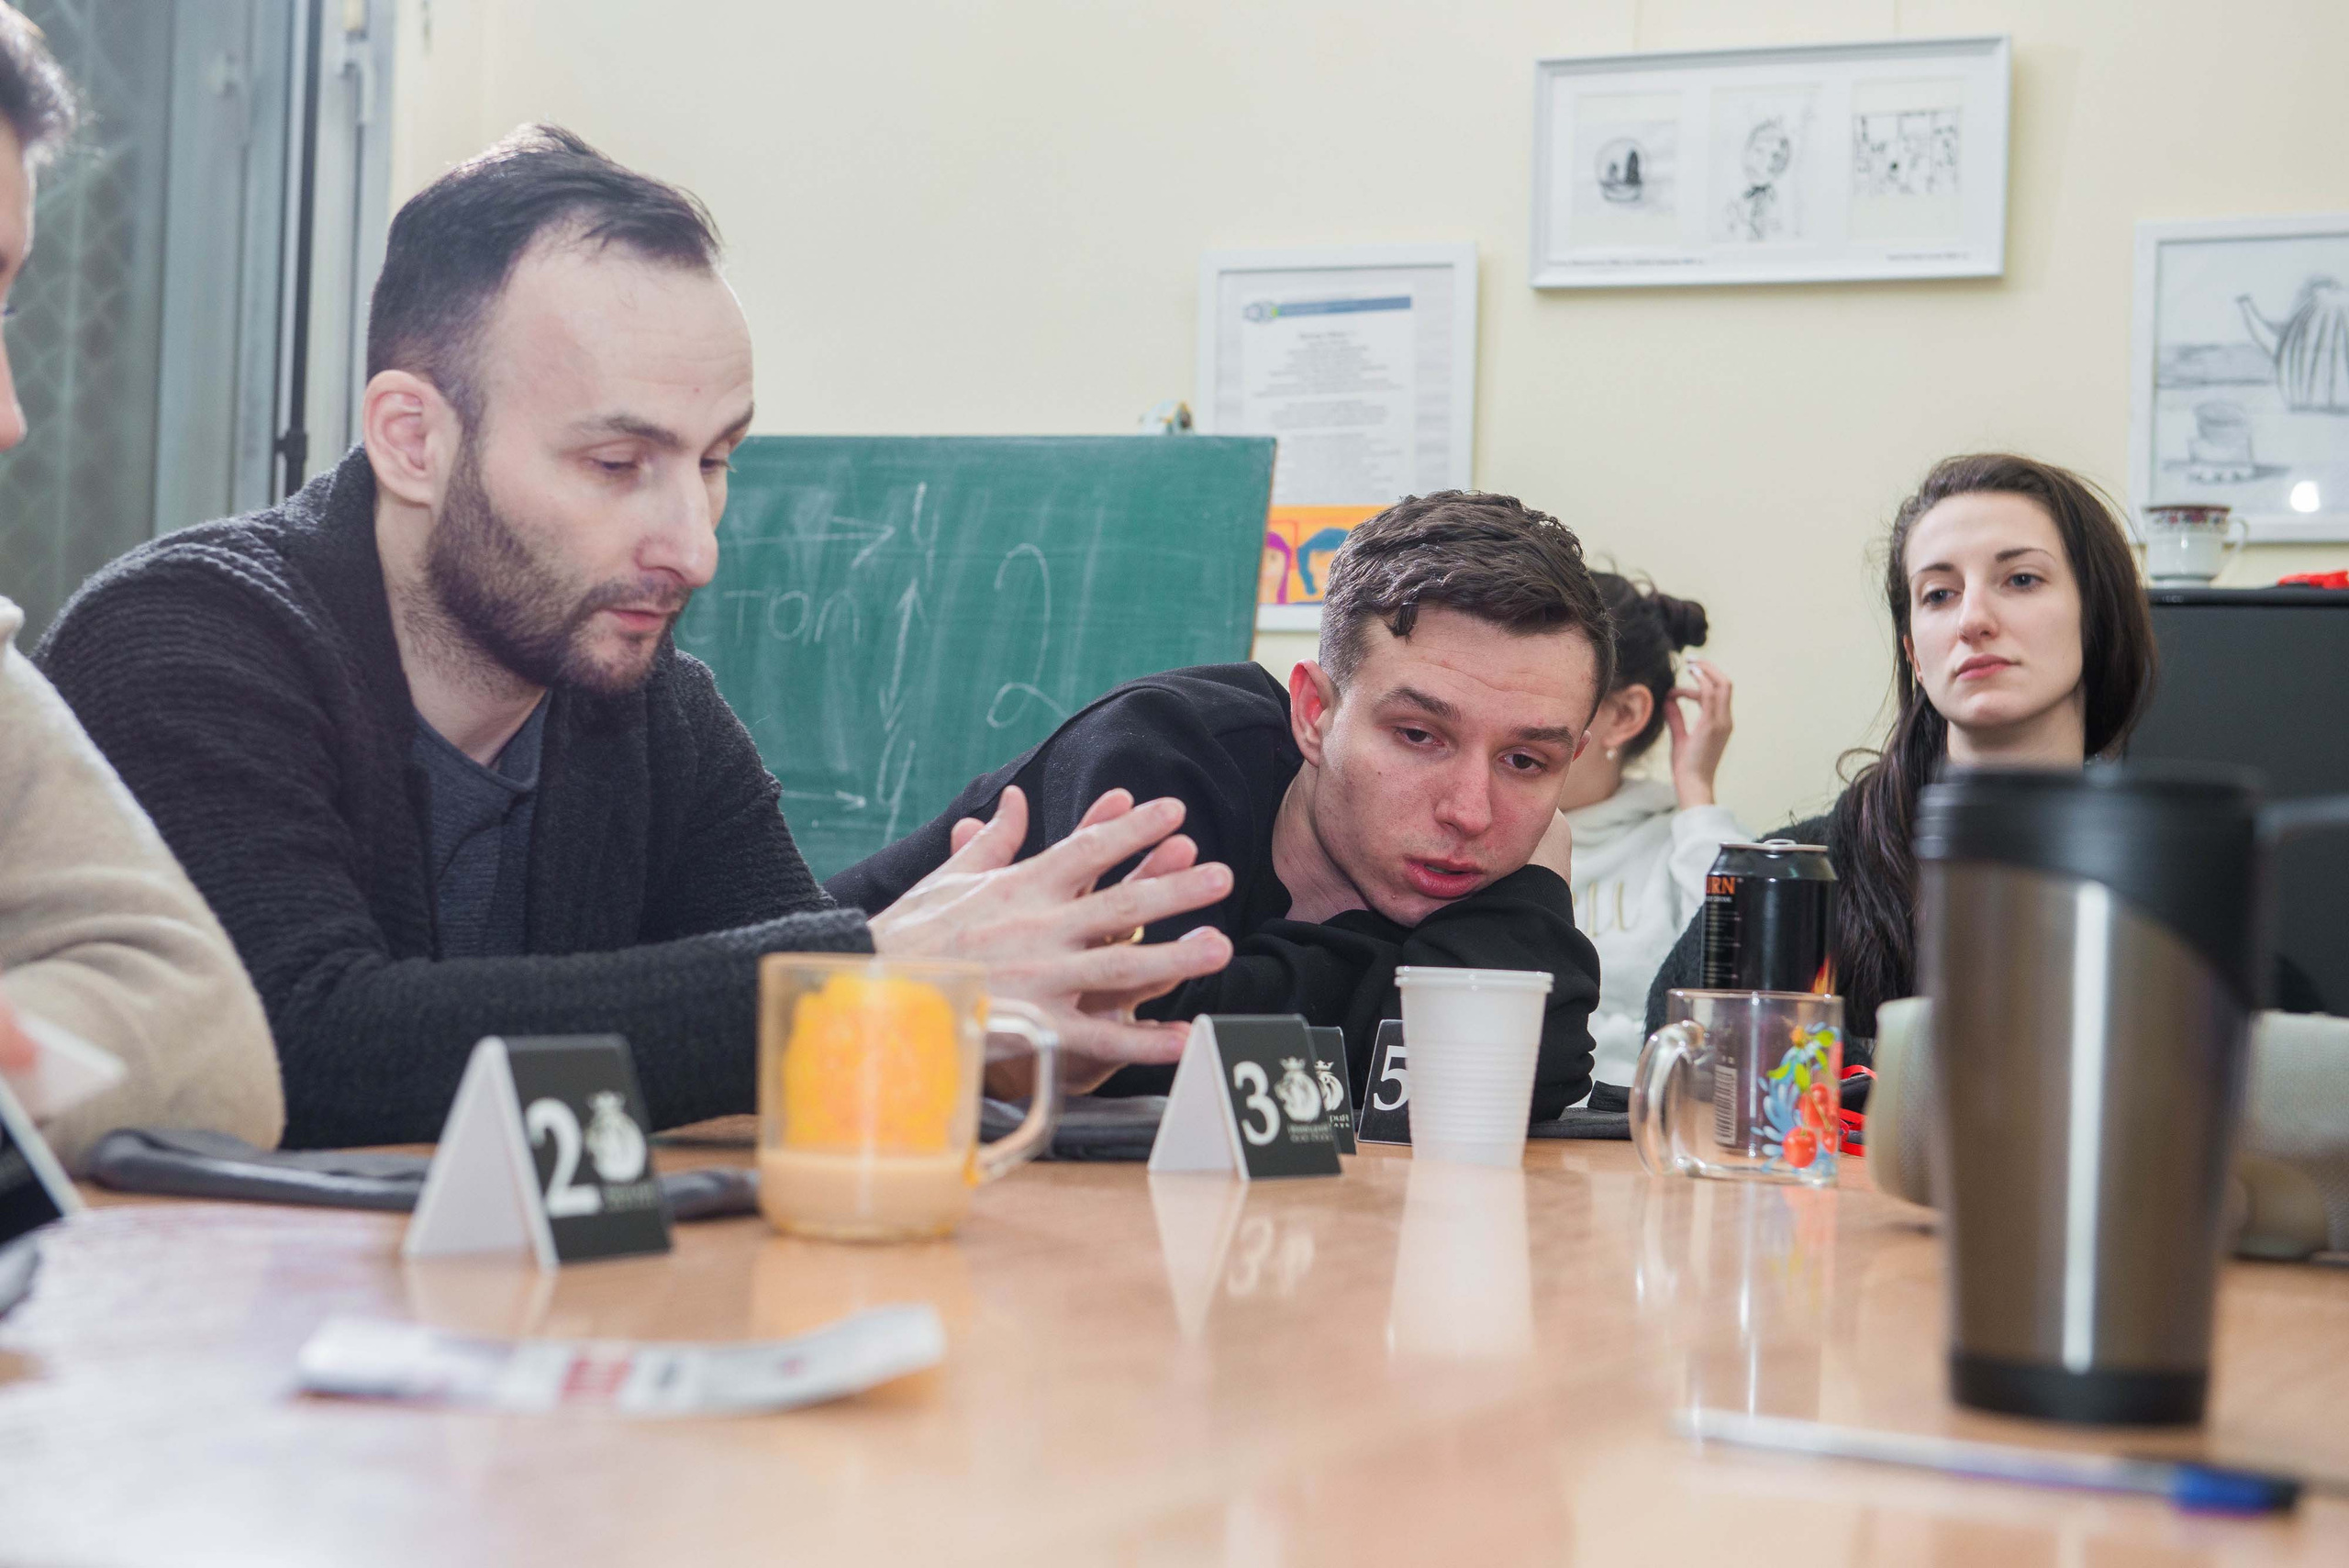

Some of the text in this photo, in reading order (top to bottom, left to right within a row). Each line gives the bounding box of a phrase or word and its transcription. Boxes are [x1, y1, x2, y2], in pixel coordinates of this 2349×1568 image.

[1233, 1060, 1281, 1146] 3
[1373, 1045, 1410, 1112] 5
[525, 1096, 603, 1218] 2
